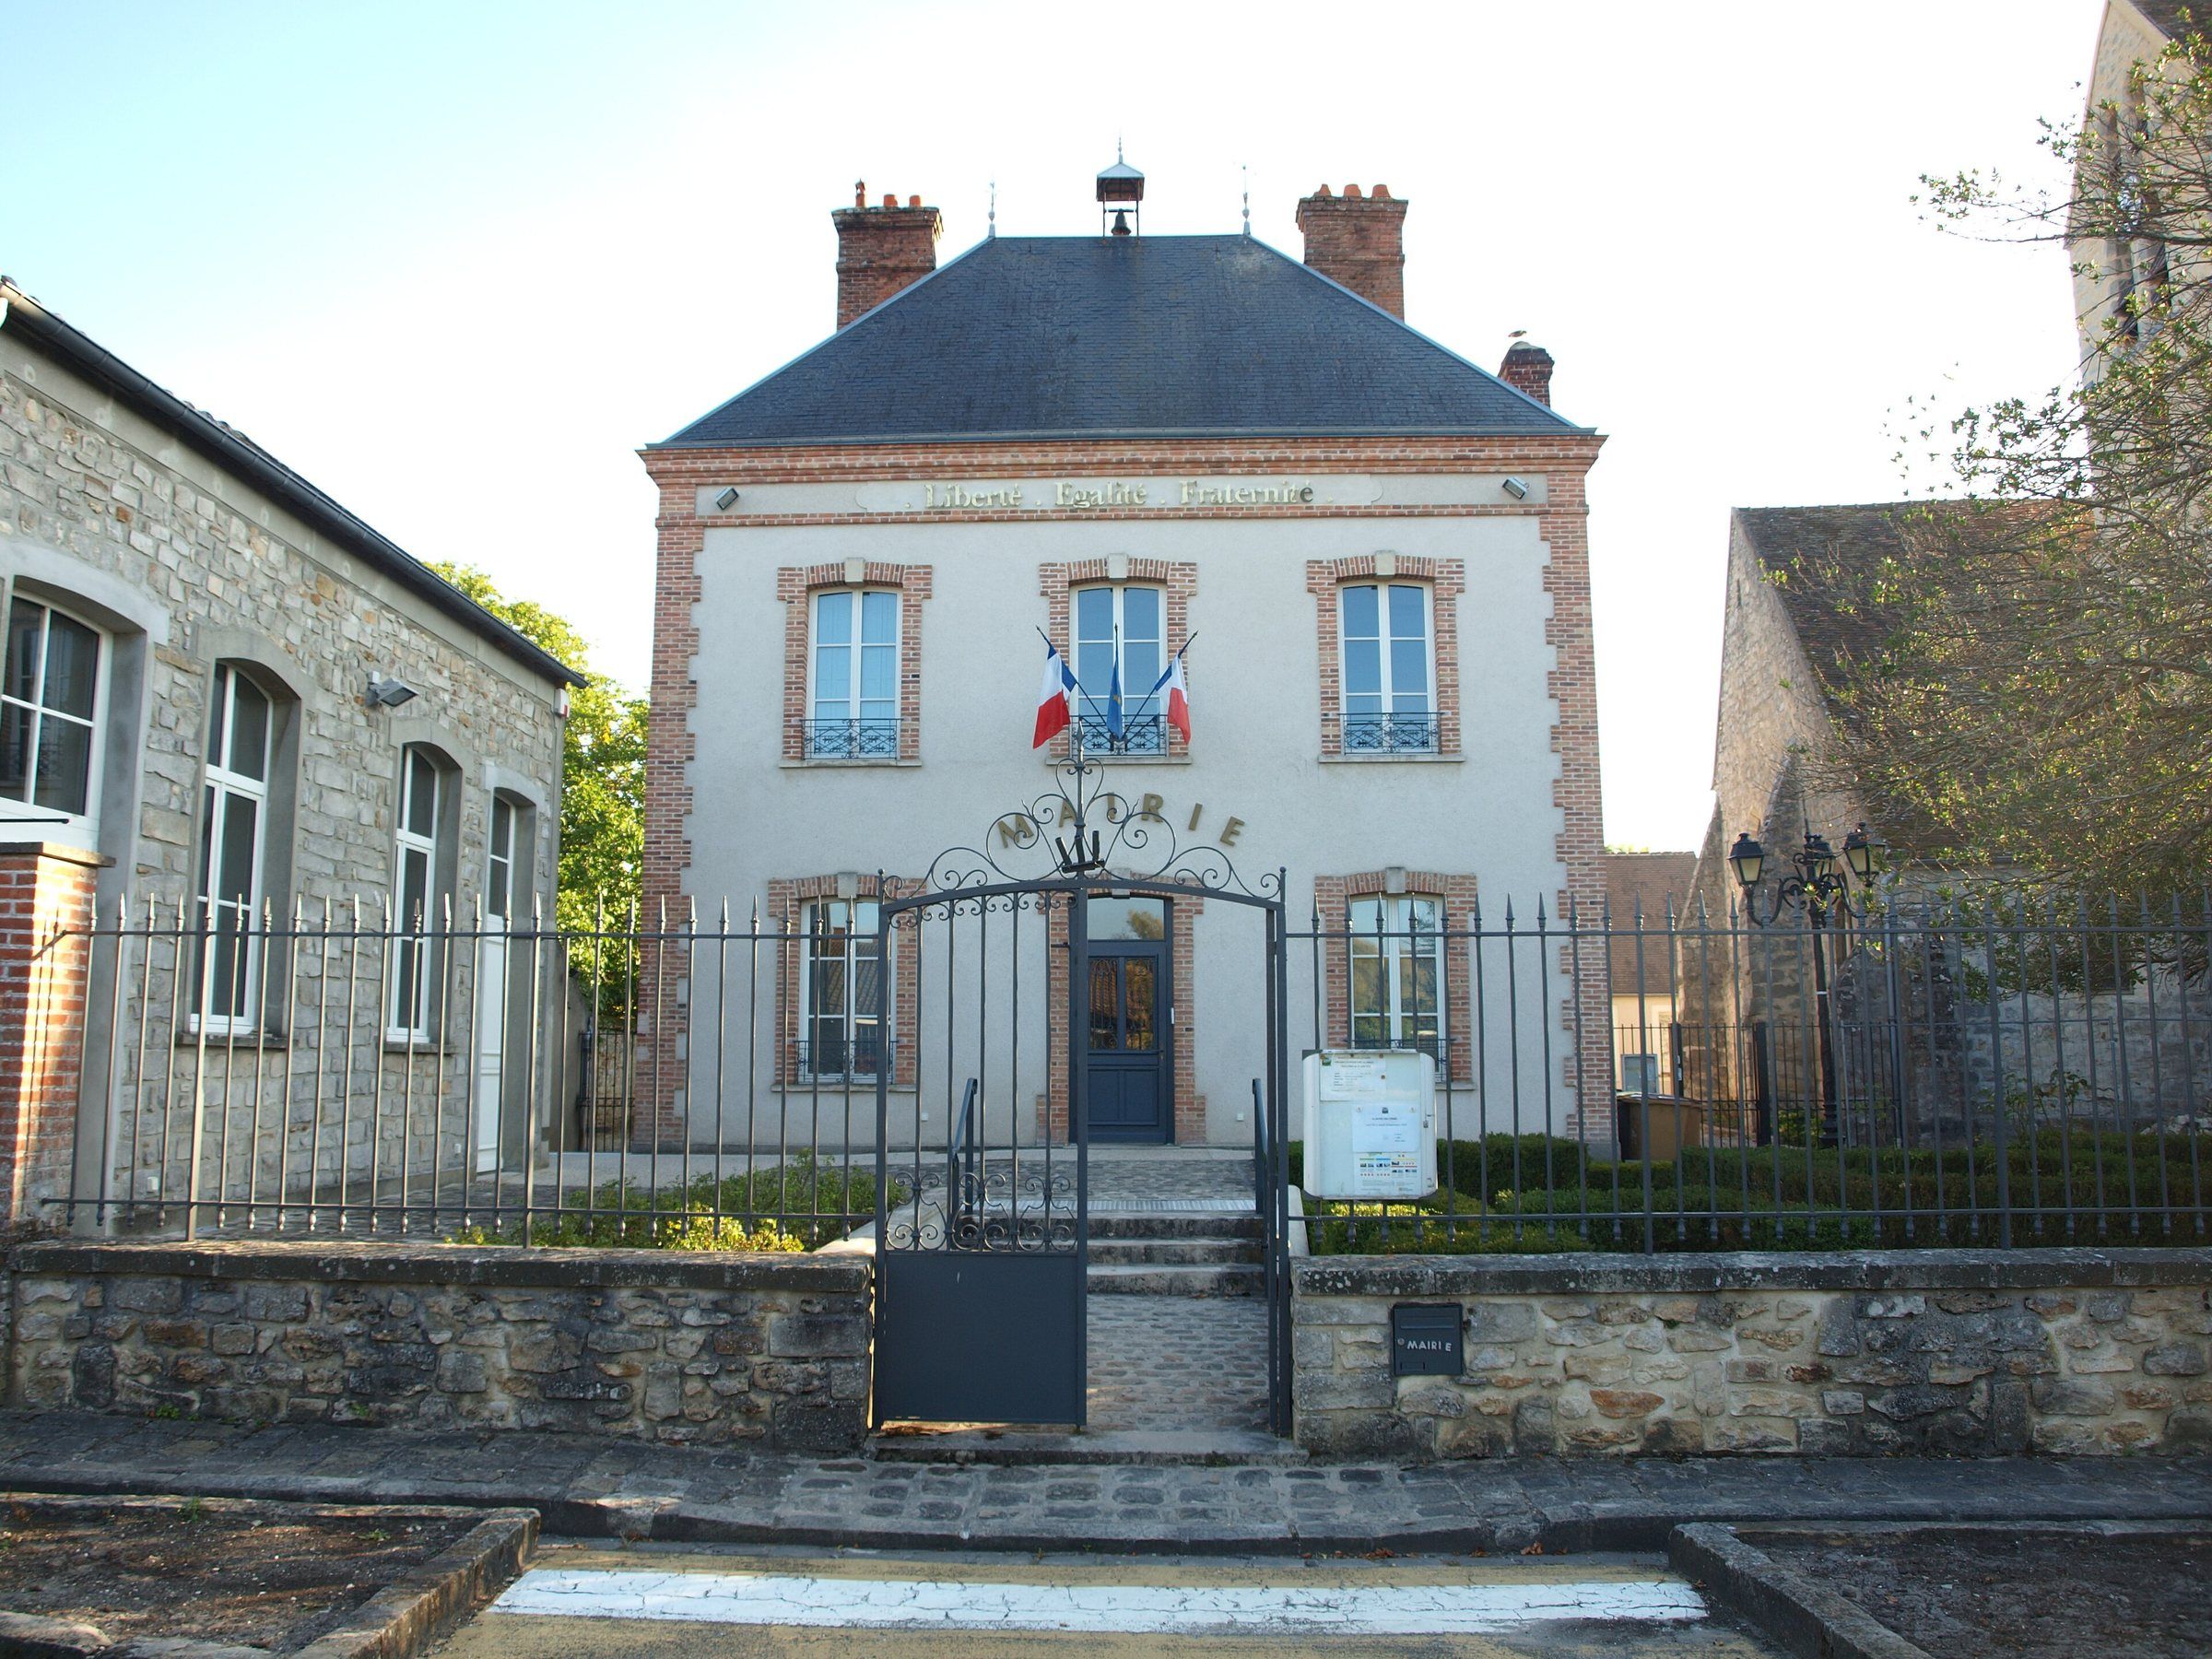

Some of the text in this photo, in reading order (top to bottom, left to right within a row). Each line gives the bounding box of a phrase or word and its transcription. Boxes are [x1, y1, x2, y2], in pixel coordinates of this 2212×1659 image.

[924, 479, 1314, 508] Liberté Egalité Fraternité
[996, 792, 1245, 849] MAIRIE
[1406, 1340, 1453, 1352] MAIRIE
